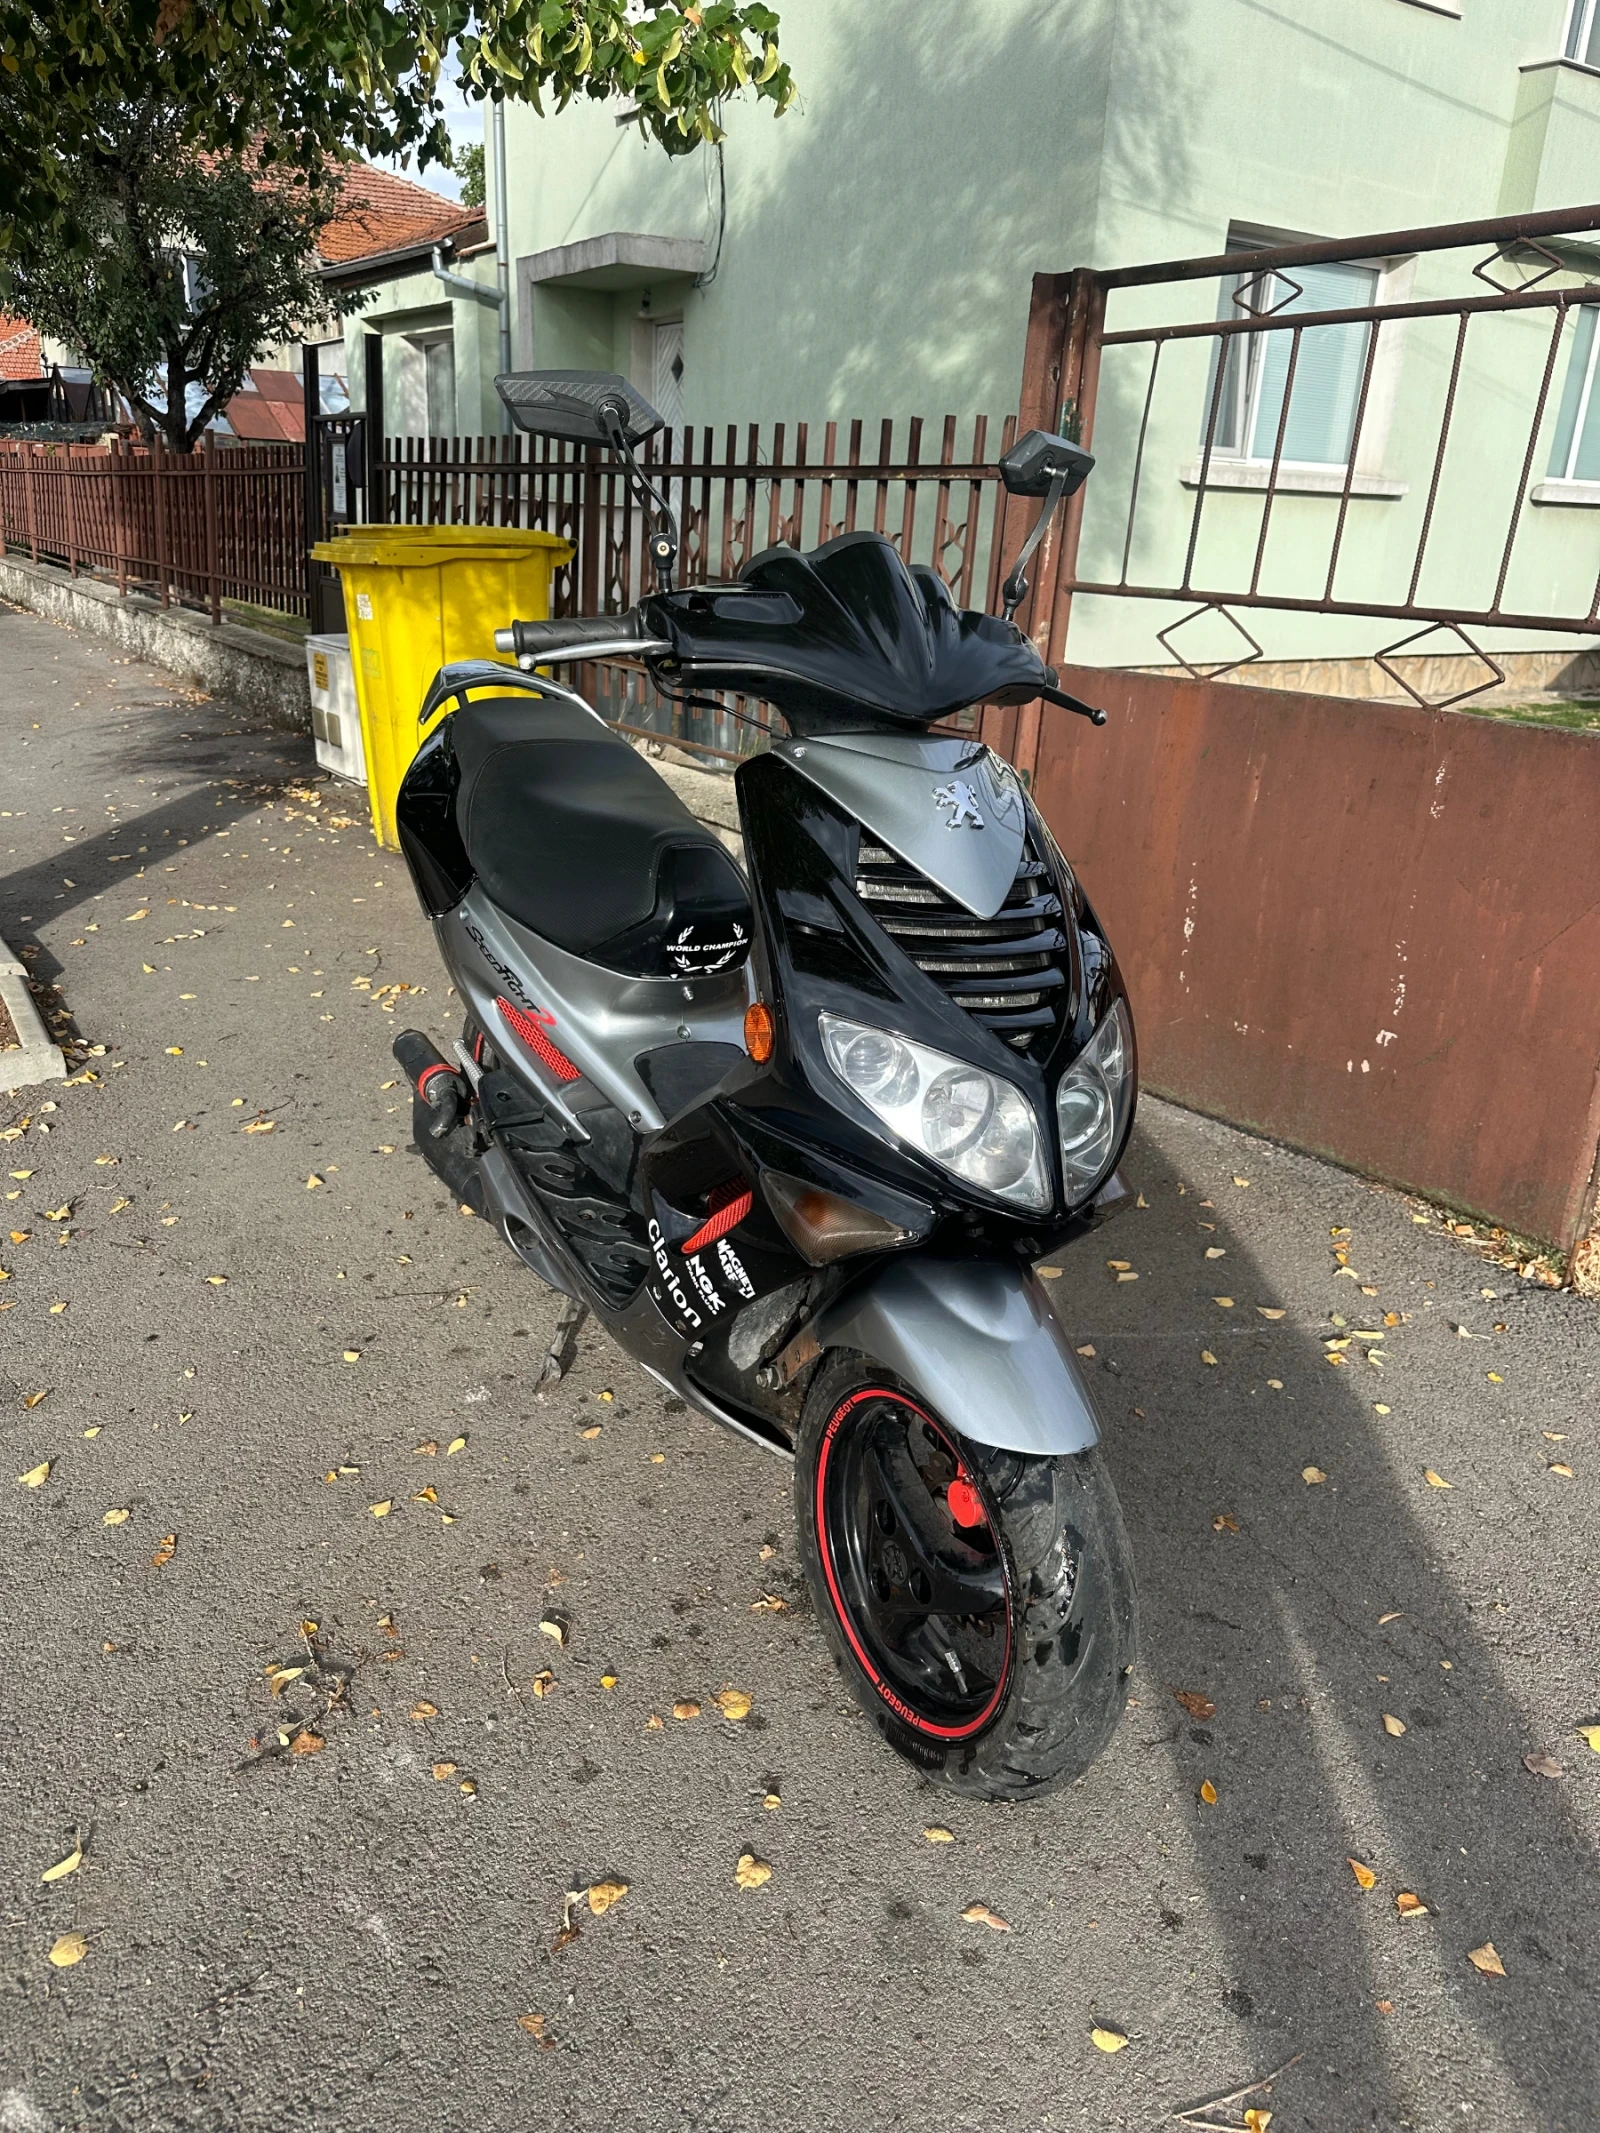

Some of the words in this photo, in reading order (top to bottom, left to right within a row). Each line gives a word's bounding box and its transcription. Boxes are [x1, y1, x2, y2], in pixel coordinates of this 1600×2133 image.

[702, 938, 749, 951] CHAMPION
[522, 1005, 557, 1039] 2
[648, 1218, 702, 1328] Clarion
[685, 1260, 700, 1289] SPARK
[698, 1290, 718, 1316] PLUGS
[690, 1254, 726, 1311] NGK
[826, 1400, 855, 1439] PEUGEOT
[877, 1682, 920, 1726] PEUGEOT
